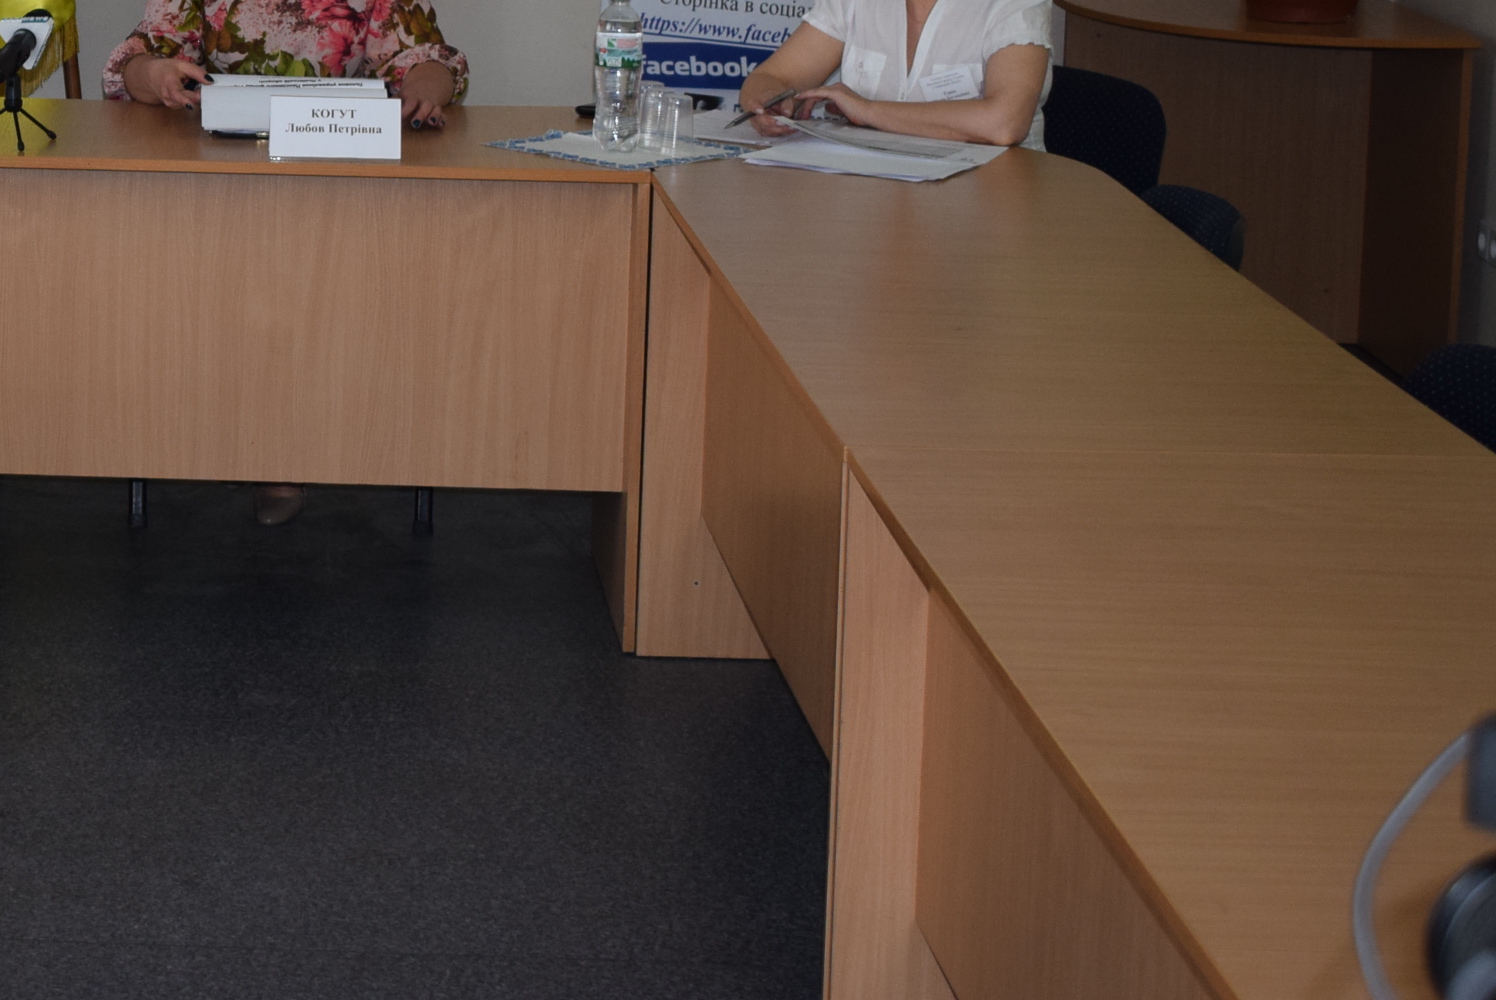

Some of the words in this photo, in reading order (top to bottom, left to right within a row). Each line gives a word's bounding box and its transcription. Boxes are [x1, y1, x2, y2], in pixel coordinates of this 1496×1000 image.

[745, 0, 754, 12] в
[759, 0, 812, 19] соціа
[311, 108, 356, 119] КОГУТ
[285, 123, 324, 134] Любов
[329, 123, 382, 136] Петрівна
